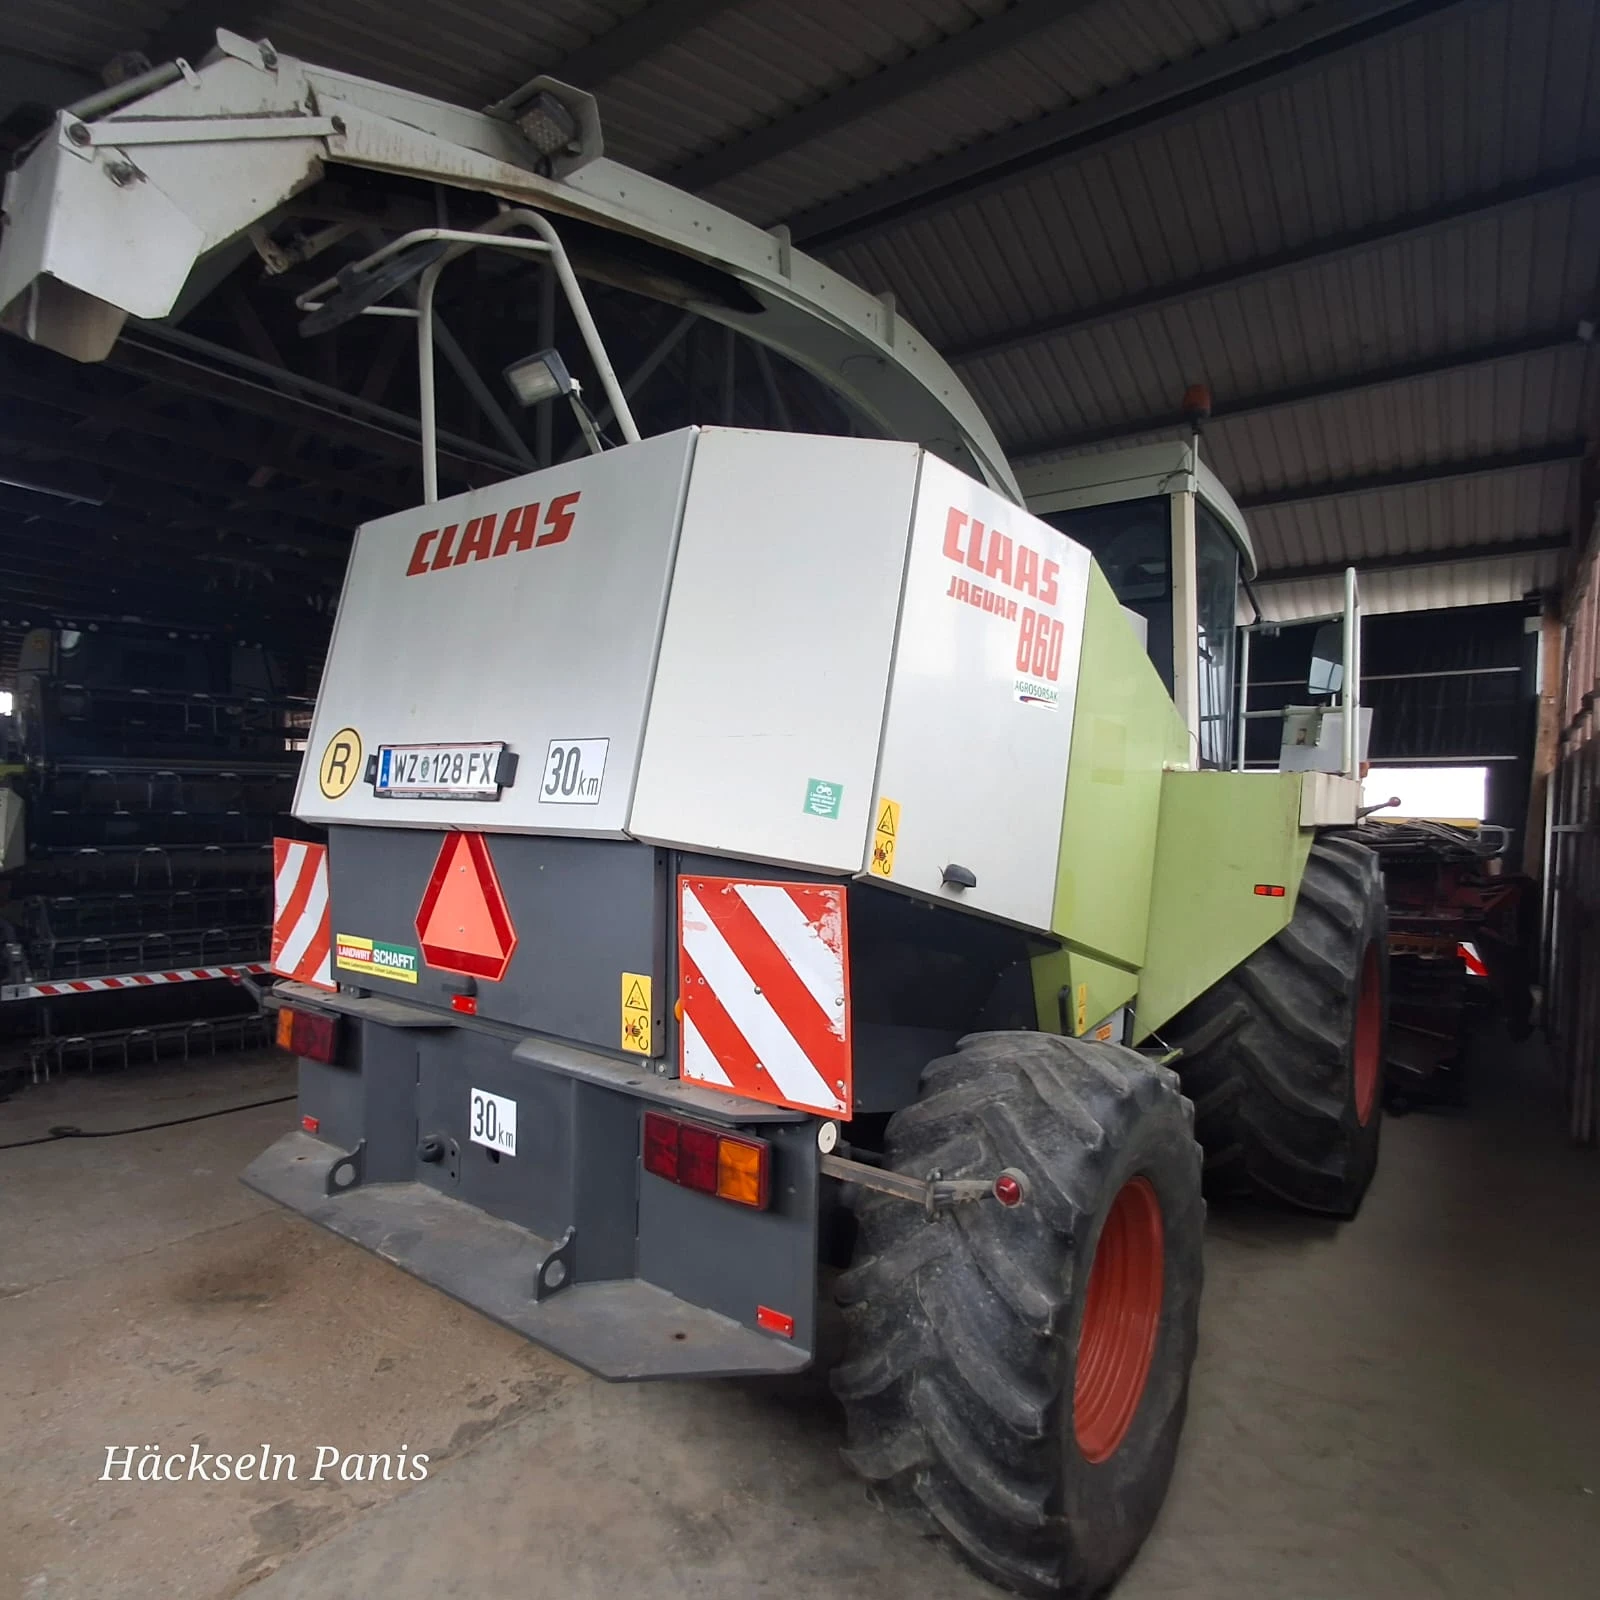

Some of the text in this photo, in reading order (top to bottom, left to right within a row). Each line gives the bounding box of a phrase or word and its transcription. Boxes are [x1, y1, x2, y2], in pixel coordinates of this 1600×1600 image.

[406, 491, 581, 577] CLAAS
[942, 506, 1060, 606] CLAAS
[946, 575, 1064, 682] JAGUAR 860
[1014, 680, 1058, 701] AGROSORSAK
[327, 743, 351, 784] R
[394, 754, 418, 783] WZ
[545, 747, 599, 796] 30 km
[338, 945, 371, 961] LANDWIRT
[373, 949, 415, 970] SCHAFFT
[474, 1096, 514, 1149] 30 km
